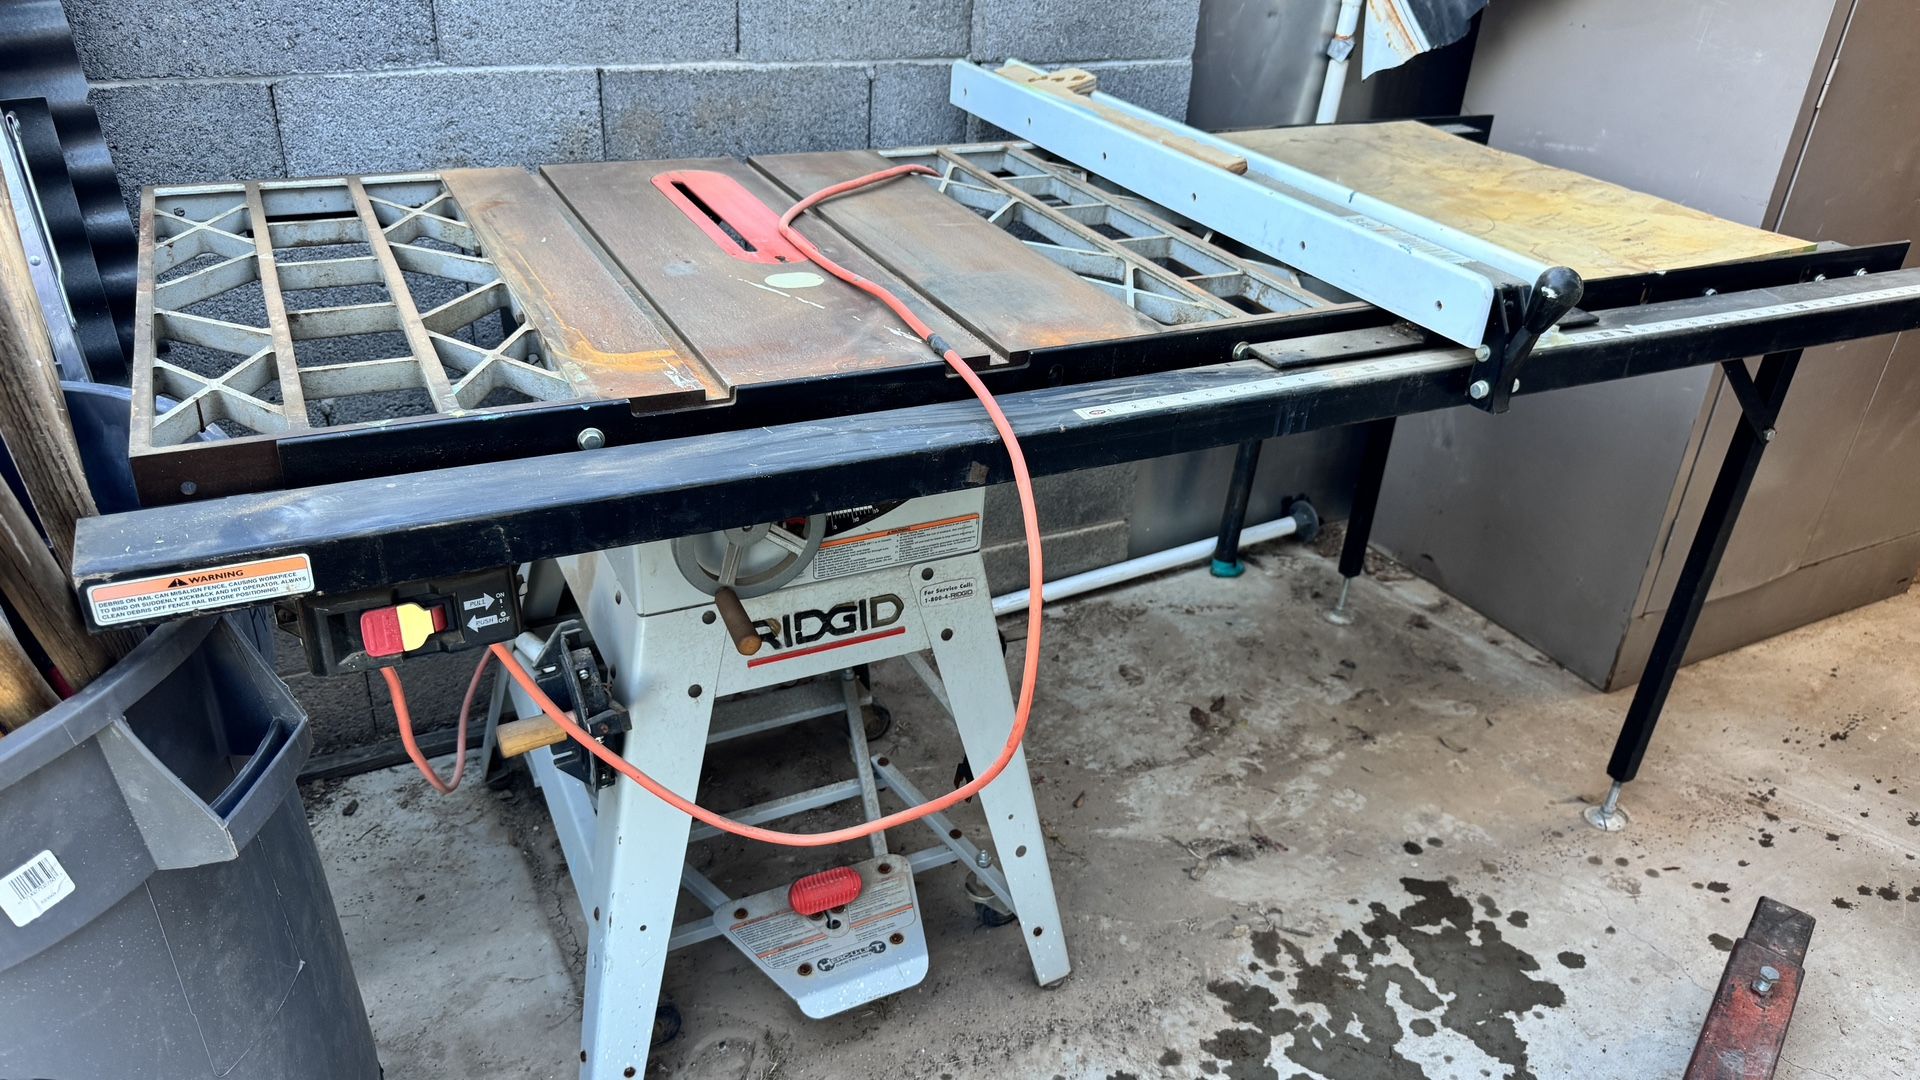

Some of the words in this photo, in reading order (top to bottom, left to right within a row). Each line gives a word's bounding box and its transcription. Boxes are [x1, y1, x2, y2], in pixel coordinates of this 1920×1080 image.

[98, 600, 125, 608] DEBRIS
[170, 586, 202, 597] MISALIGN
[228, 578, 258, 587] CAUSING
[258, 572, 297, 582] WORKPIECE
[111, 605, 129, 613] BIND
[141, 597, 178, 608] SUDDENLY
[179, 591, 215, 603] KICKBACK
[280, 575, 307, 585] ALWAYS
[188, 569, 244, 584] WARNING
[101, 612, 126, 620] CLEAN
[126, 608, 152, 617] DEBRIS
[167, 601, 190, 609] FENCE
[190, 598, 207, 606] RAIL
[208, 593, 235, 603] BEFORE
[235, 586, 280, 598] POSITIONING!
[470, 599, 485, 607] PULL
[751, 593, 905, 650] RIDGID
